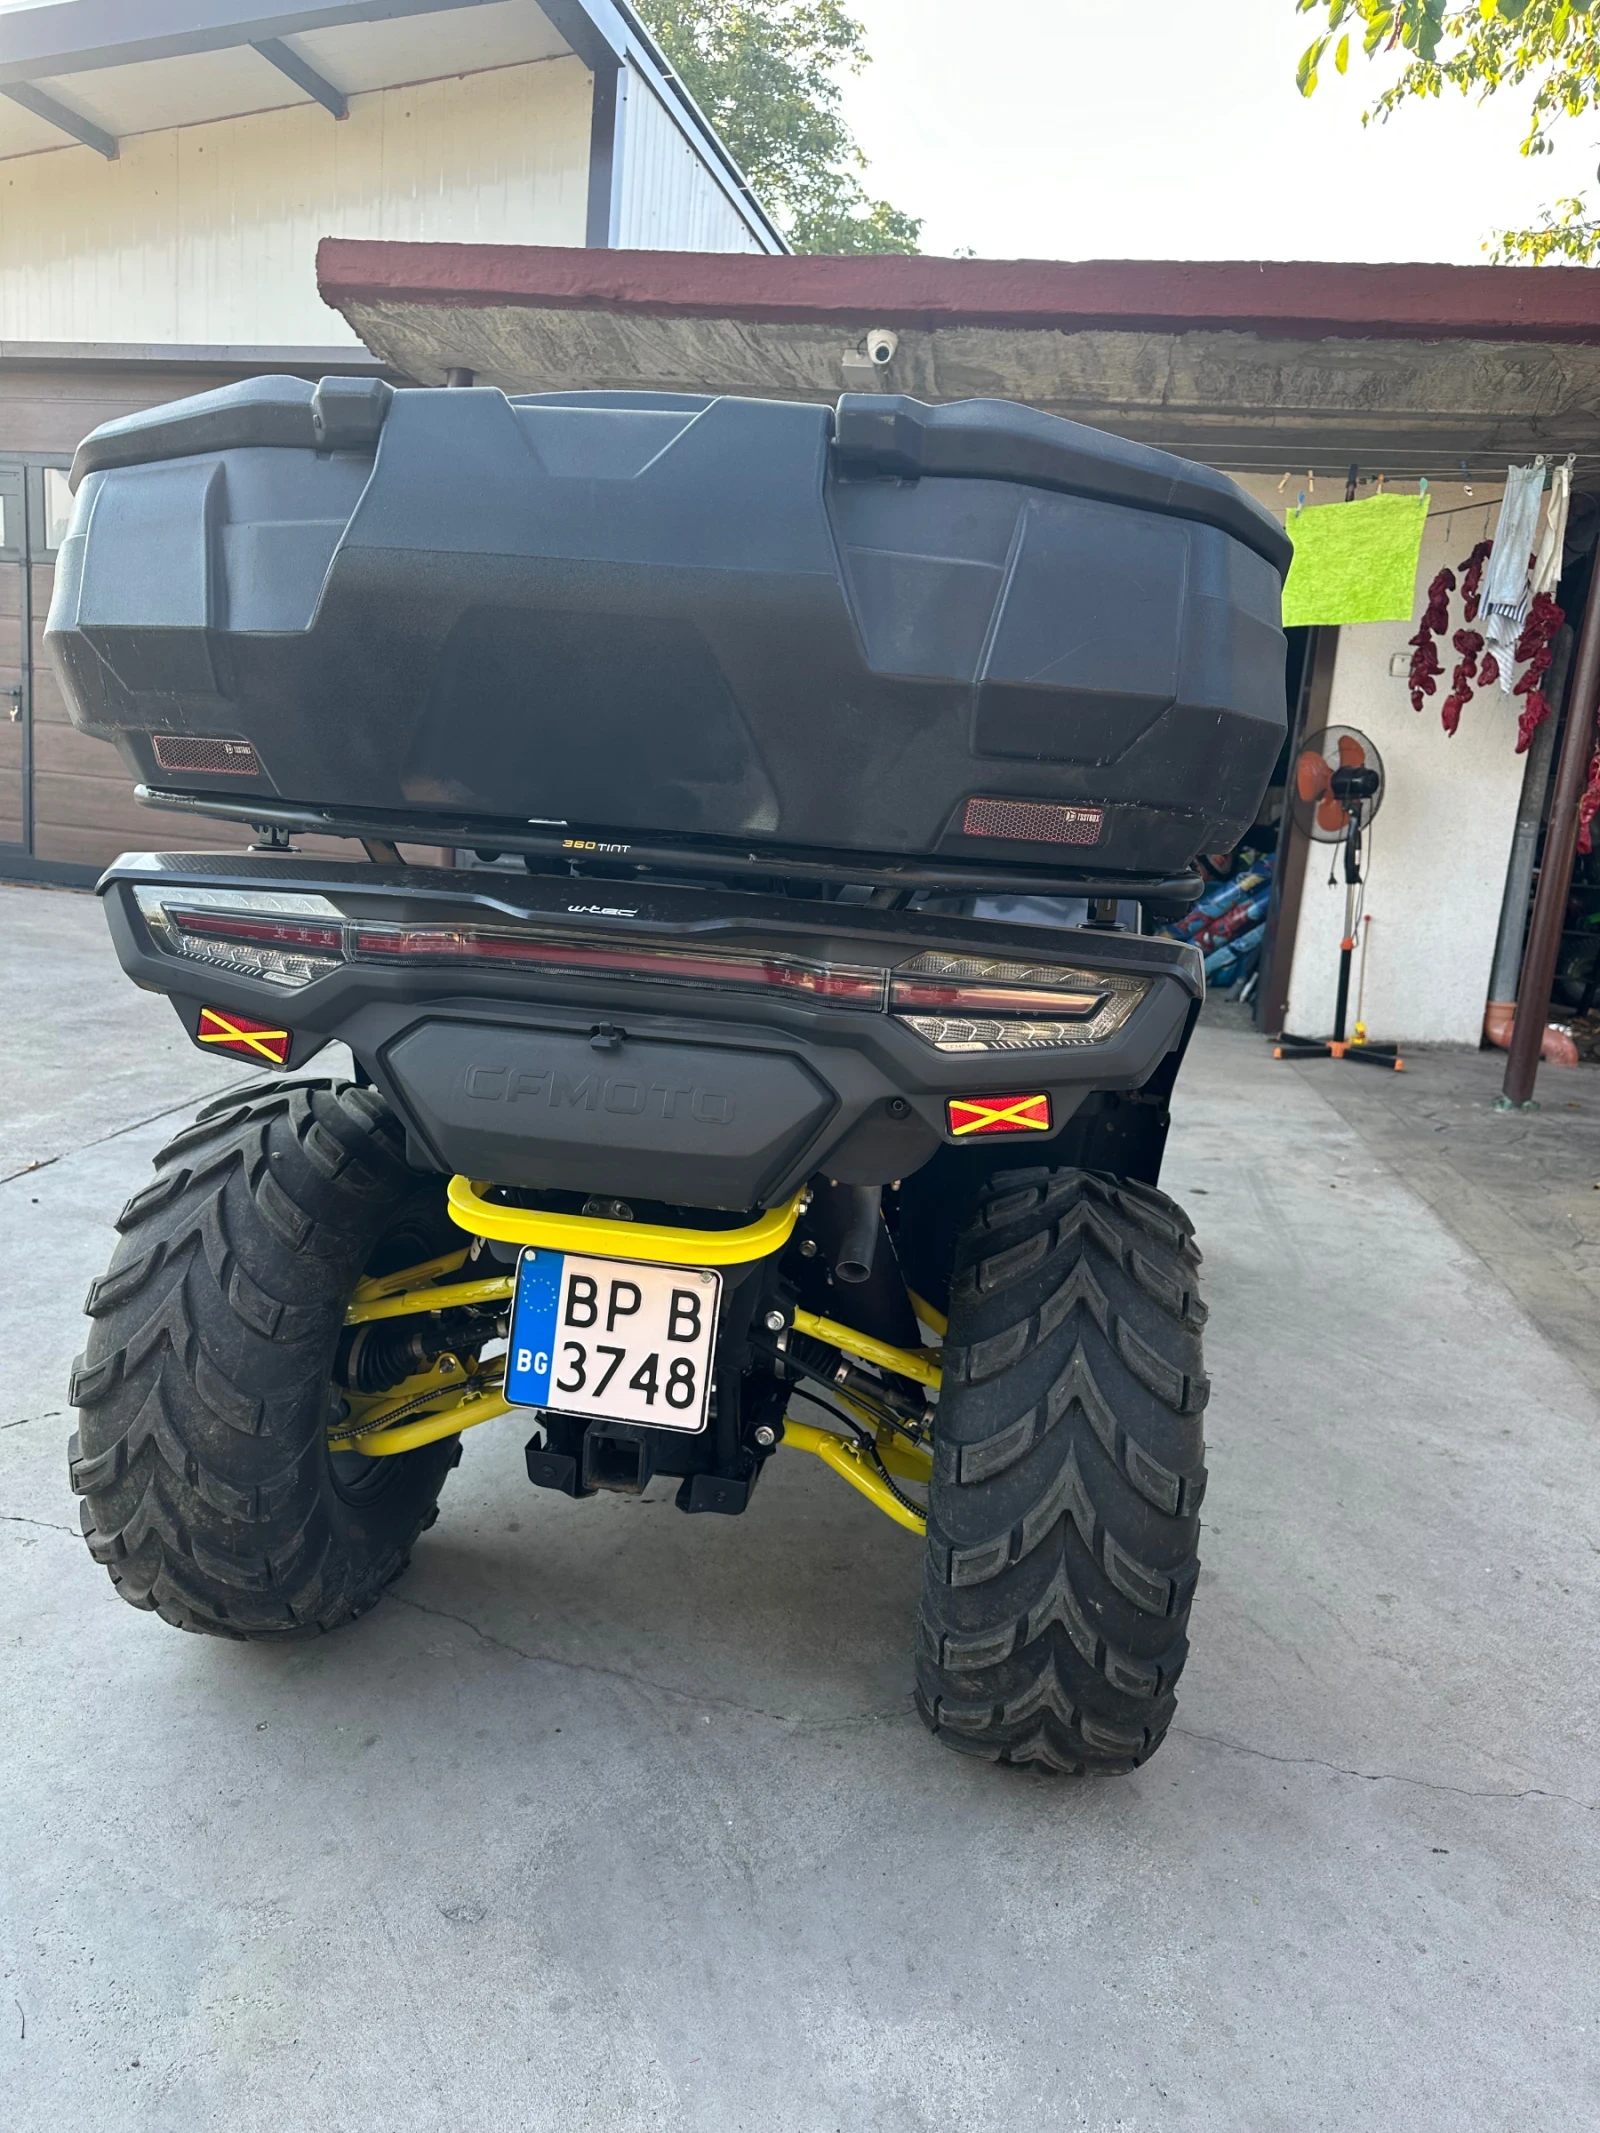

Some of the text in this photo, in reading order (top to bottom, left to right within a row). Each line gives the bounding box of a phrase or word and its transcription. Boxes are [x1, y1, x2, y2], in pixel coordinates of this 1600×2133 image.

[463, 1063, 737, 1125] CFMOTO
[564, 1273, 702, 1343] BP B
[516, 1348, 549, 1375] BG
[556, 1341, 697, 1410] 3748
